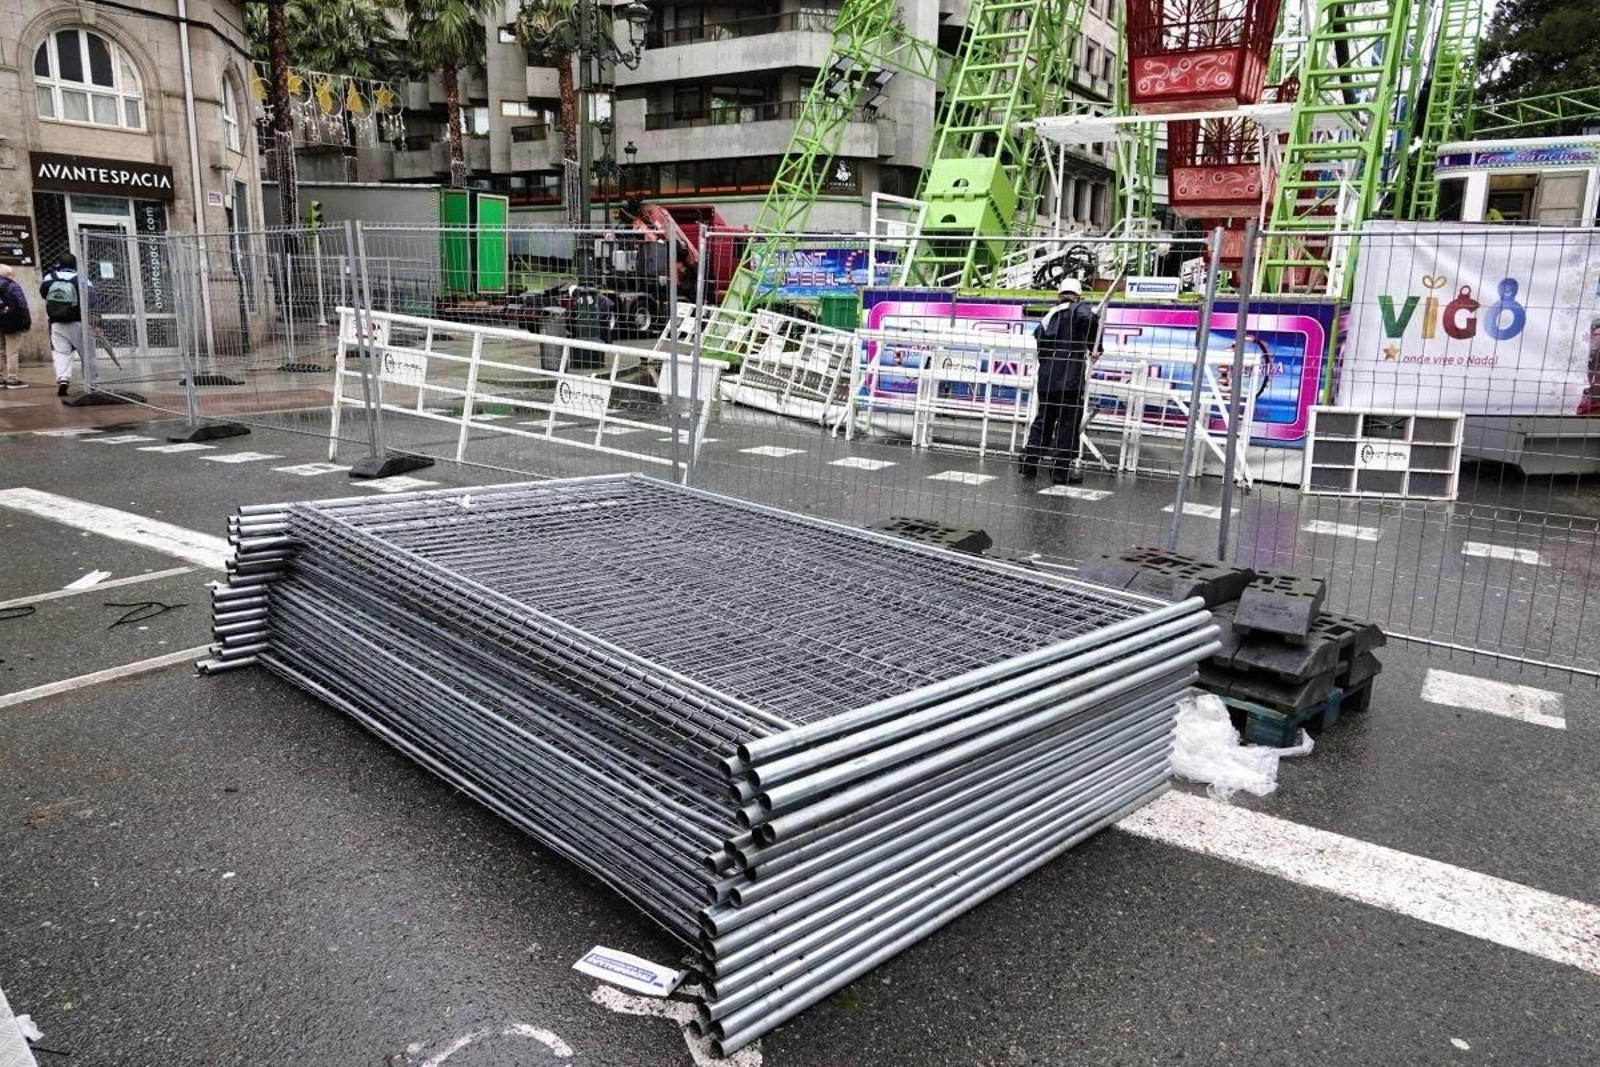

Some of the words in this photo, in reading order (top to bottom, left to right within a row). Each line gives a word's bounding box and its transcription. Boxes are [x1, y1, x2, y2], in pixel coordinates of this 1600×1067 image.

[38, 163, 171, 189] AVANTESPACIA
[1403, 354, 1430, 364] onde
[1433, 355, 1454, 365] vive
[1467, 355, 1499, 365] Nadal
